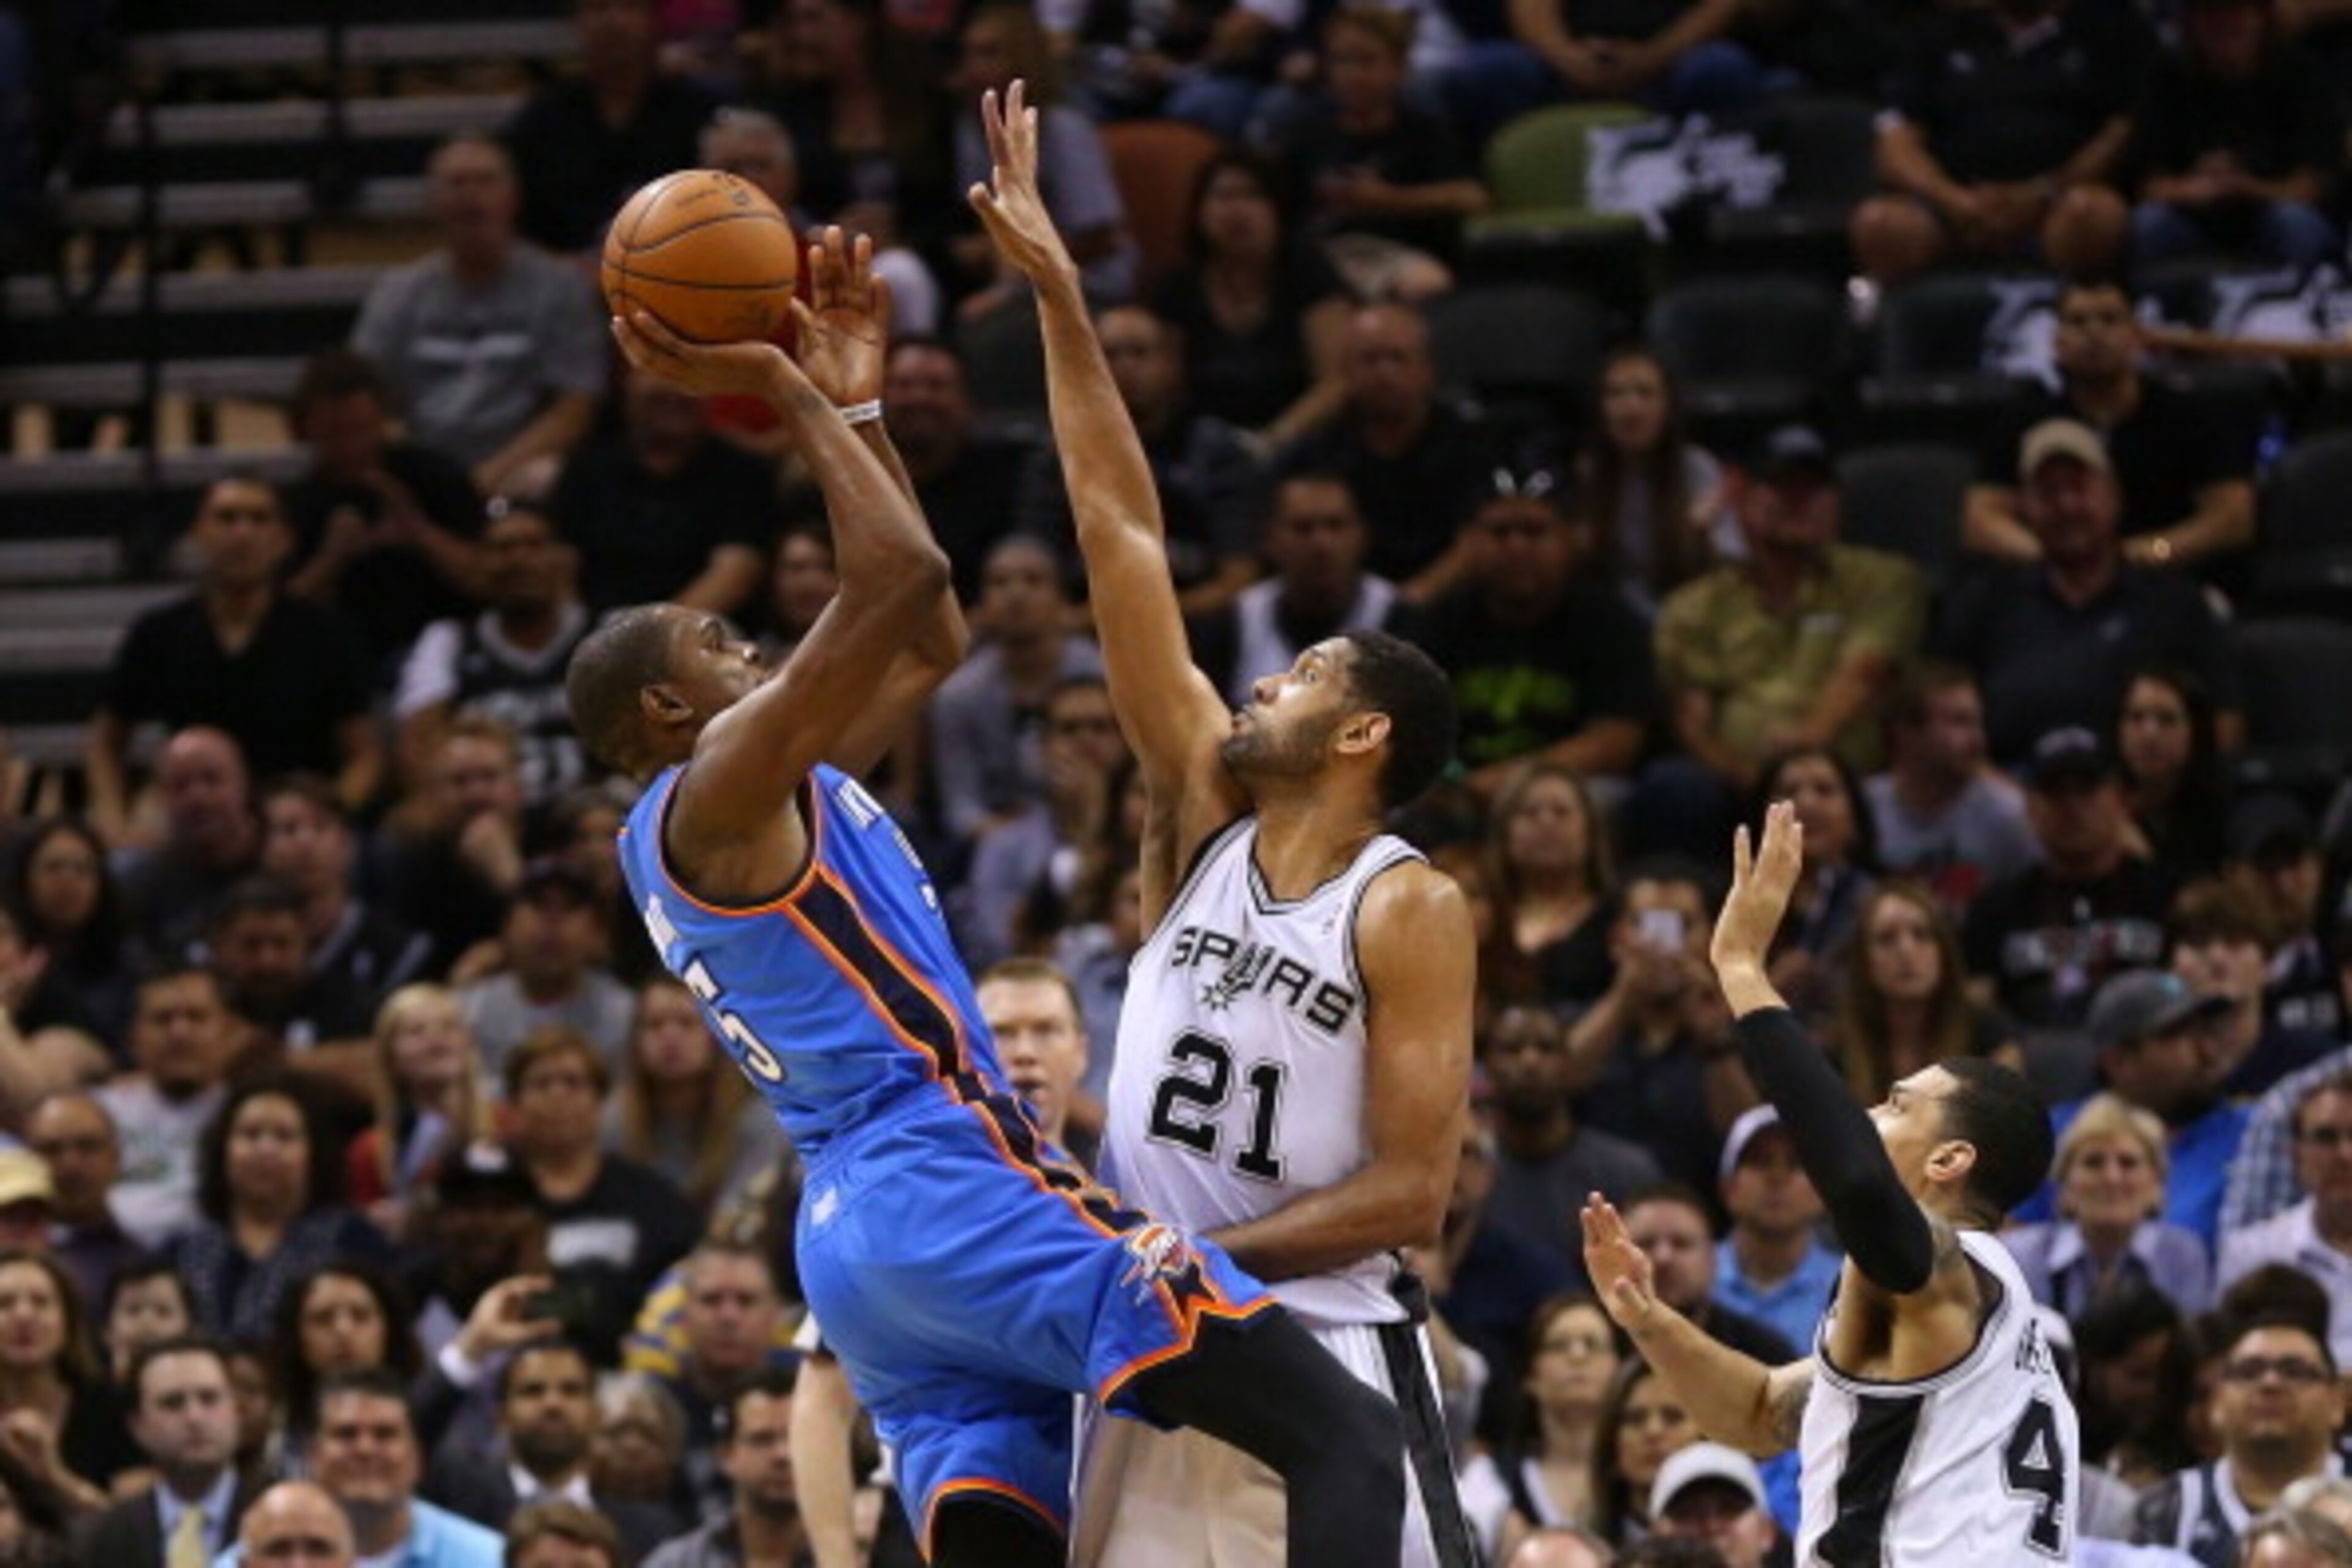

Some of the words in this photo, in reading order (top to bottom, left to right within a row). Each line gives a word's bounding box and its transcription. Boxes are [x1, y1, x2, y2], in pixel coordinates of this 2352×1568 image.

[681, 951, 788, 1084] 5
[1171, 926, 1357, 1036] SPURS
[1145, 1027, 1287, 1185] 21
[2000, 1393, 2068, 1561] 4
